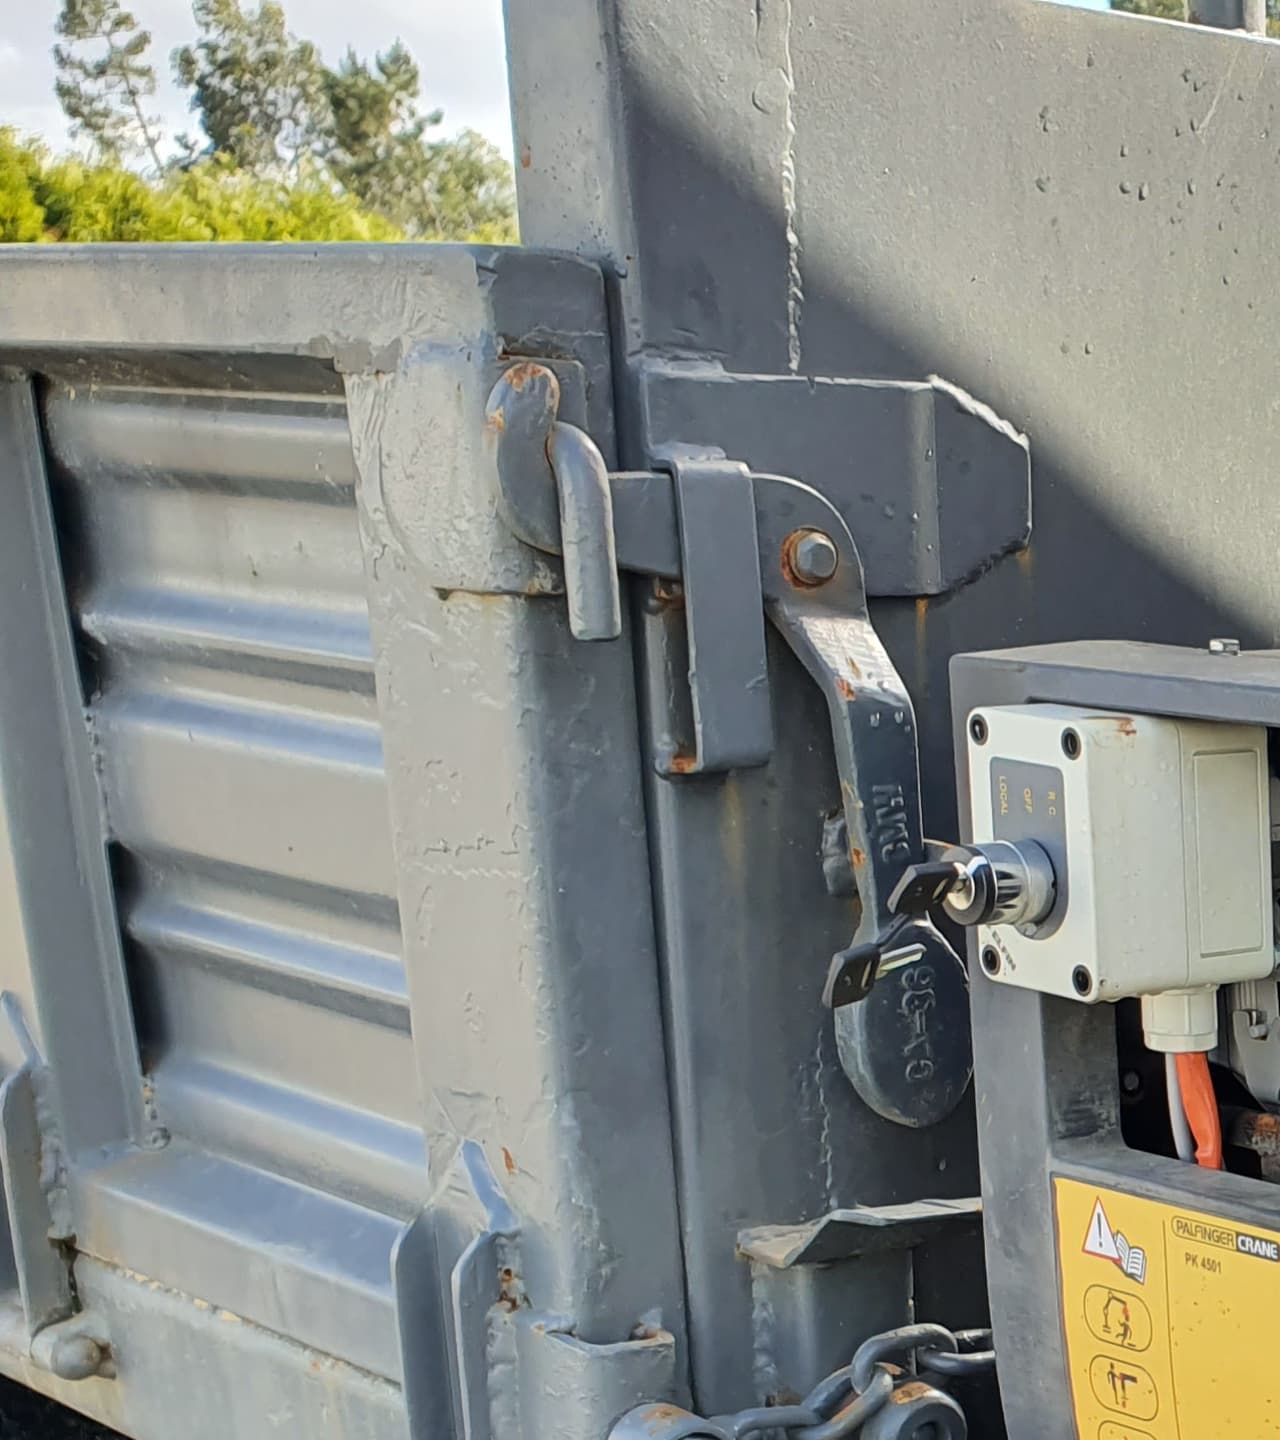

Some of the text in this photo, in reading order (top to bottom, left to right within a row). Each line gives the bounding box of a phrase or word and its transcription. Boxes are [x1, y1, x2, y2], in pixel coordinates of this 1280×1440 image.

[999, 775, 1009, 816] LOCAL
[1023, 787, 1033, 814] OFF
[1175, 1219, 1279, 1260] PALFINGER CRANE
[1184, 1251, 1222, 1274] PK 4501
